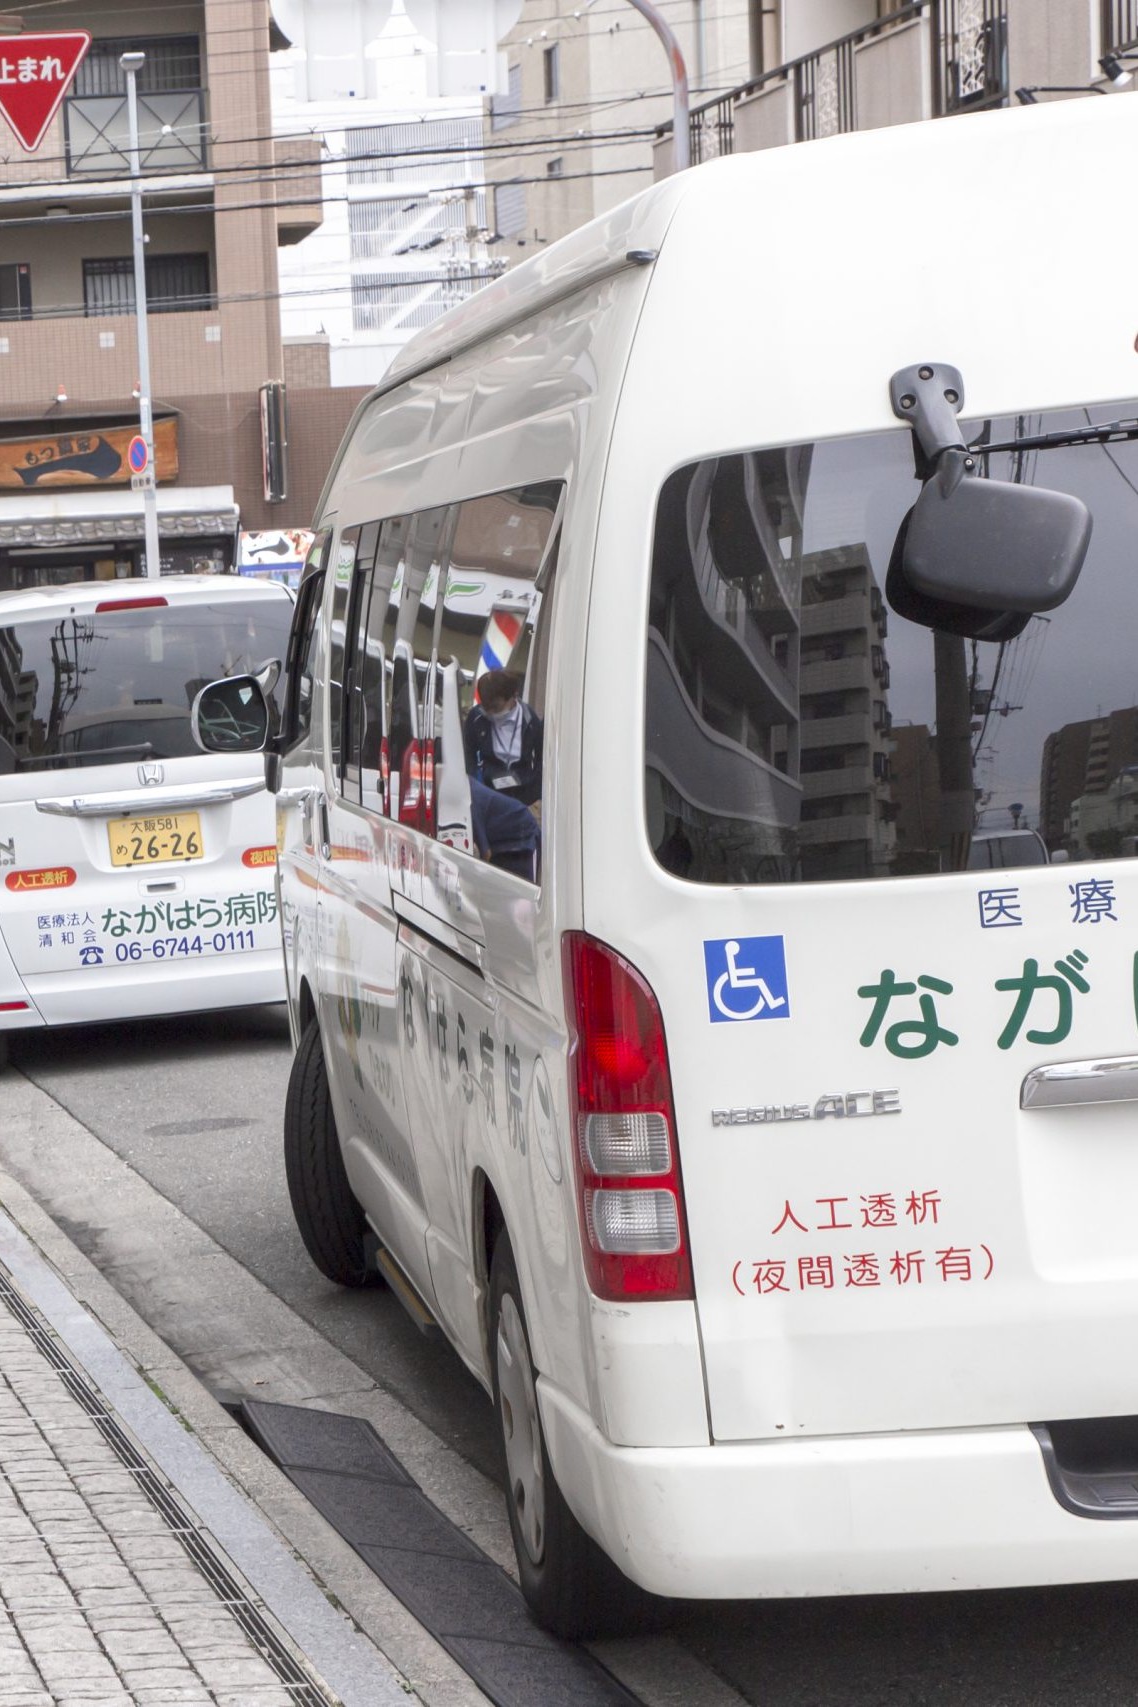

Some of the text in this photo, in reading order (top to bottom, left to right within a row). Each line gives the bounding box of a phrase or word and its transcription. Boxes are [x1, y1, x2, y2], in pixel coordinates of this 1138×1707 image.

[116, 831, 198, 860] め 26-26
[14, 871, 68, 889] 人工透析
[37, 911, 95, 930] 医療法人
[101, 891, 277, 938] ながはら病院
[115, 929, 255, 962] 06-6744-0111
[771, 1189, 942, 1235] 人工透析
[732, 1244, 995, 1296] （夜間透析有）
